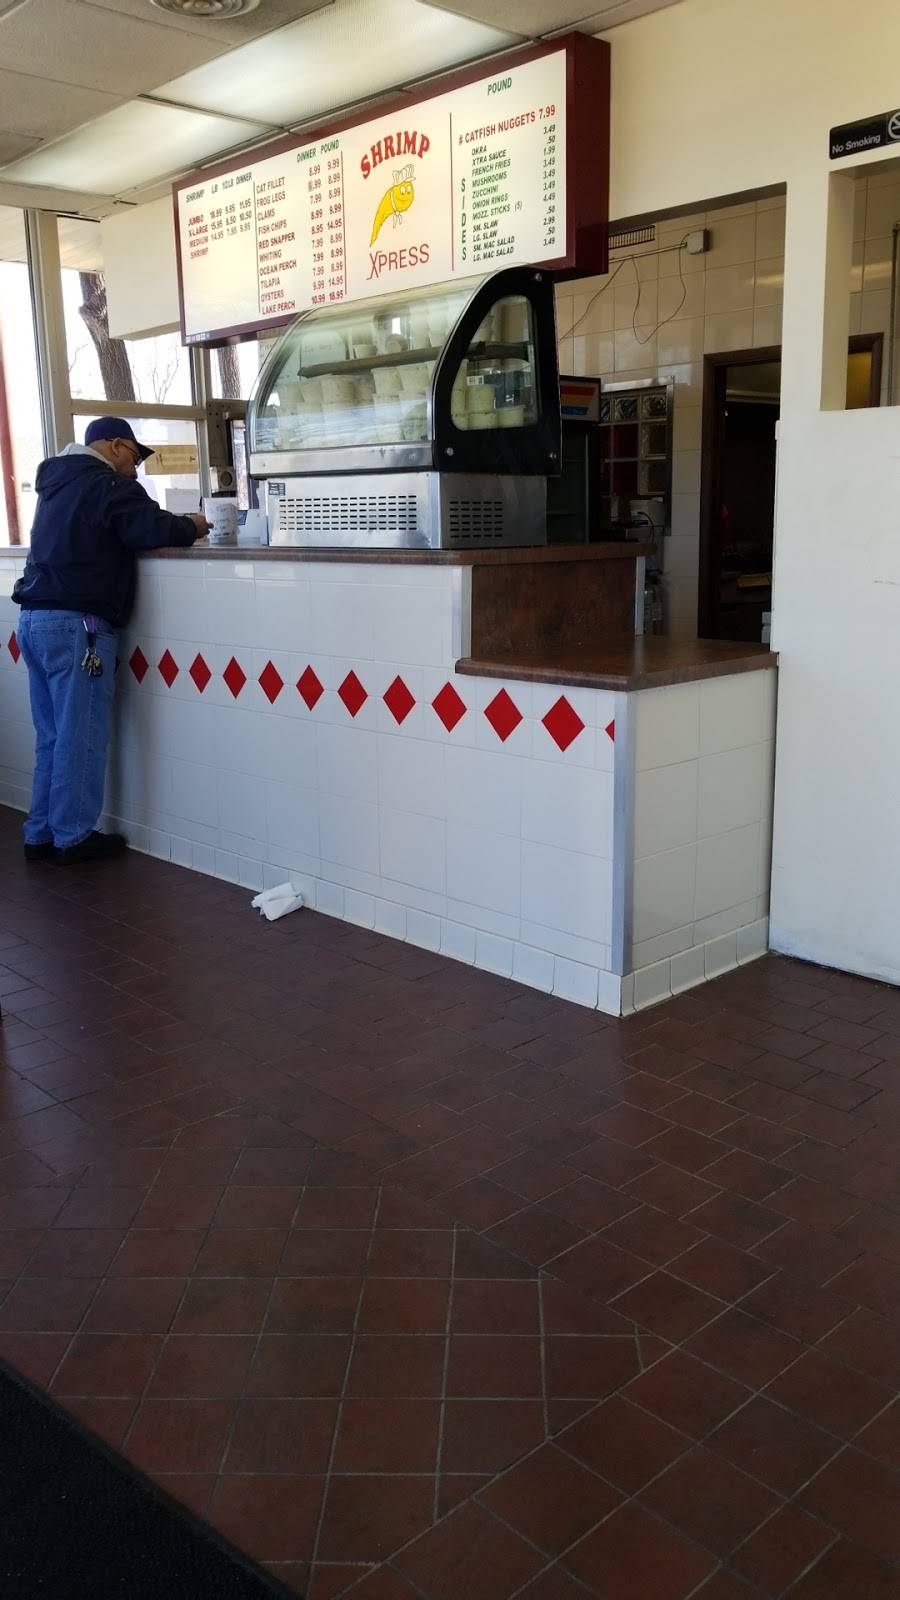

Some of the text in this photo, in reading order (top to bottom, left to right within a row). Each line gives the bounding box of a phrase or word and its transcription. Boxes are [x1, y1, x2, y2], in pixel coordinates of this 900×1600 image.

[488, 77, 512, 96] POUND
[465, 124, 496, 143] CATFISH
[498, 111, 535, 133] NUGGETS
[539, 105, 555, 119] 7.99
[472, 124, 555, 156] OKRA 3.49
[832, 135, 880, 154] No Smoking
[297, 140, 339, 163] DINNER POUND
[360, 131, 430, 179] SHRIMP
[472, 135, 555, 166] XTRA SAUCE .50
[472, 164, 493, 177] FRENCH
[495, 159, 511, 170] FRIES
[472, 157, 555, 187] MUSHROOMS 3.49
[236, 172, 252, 185] DINNER
[256, 183, 266, 194] CAT
[267, 177, 285, 190] FILLET
[472, 169, 555, 199] ZUCCHINI 3.49
[257, 196, 270, 206] FROG
[272, 191, 285, 203] LEGS
[472, 181, 555, 209] ONION RINGS 3.49
[258, 209, 275, 221] CLAMS
[310, 193, 322, 204] 7.99
[490, 204, 510, 216] STICKS
[258, 225, 270, 235] FISH
[271, 219, 287, 232] CHIPS
[473, 224, 482, 232] SM.
[484, 220, 498, 229] SLAW
[482, 230, 497, 239] SLAW
[259, 240, 269, 250] RED
[271, 232, 295, 246] SNAPPER
[473, 244, 482, 252] SM.
[484, 240, 495, 249] MAC
[497, 236, 515, 246] SALAD
[483, 250, 494, 259] MAC
[496, 246, 514, 256] SALAD
[544, 237, 555, 246] 3.49
[259, 249, 281, 262] WHITING
[366, 244, 430, 280] XPRESS
[260, 264, 278, 276] OCEAN
[279, 259, 296, 270] PERCH
[261, 278, 280, 288] TILAPIA
[261, 290, 284, 302] OYSTERS
[262, 304, 276, 315] LAKE
[278, 300, 295, 311] PERCH
